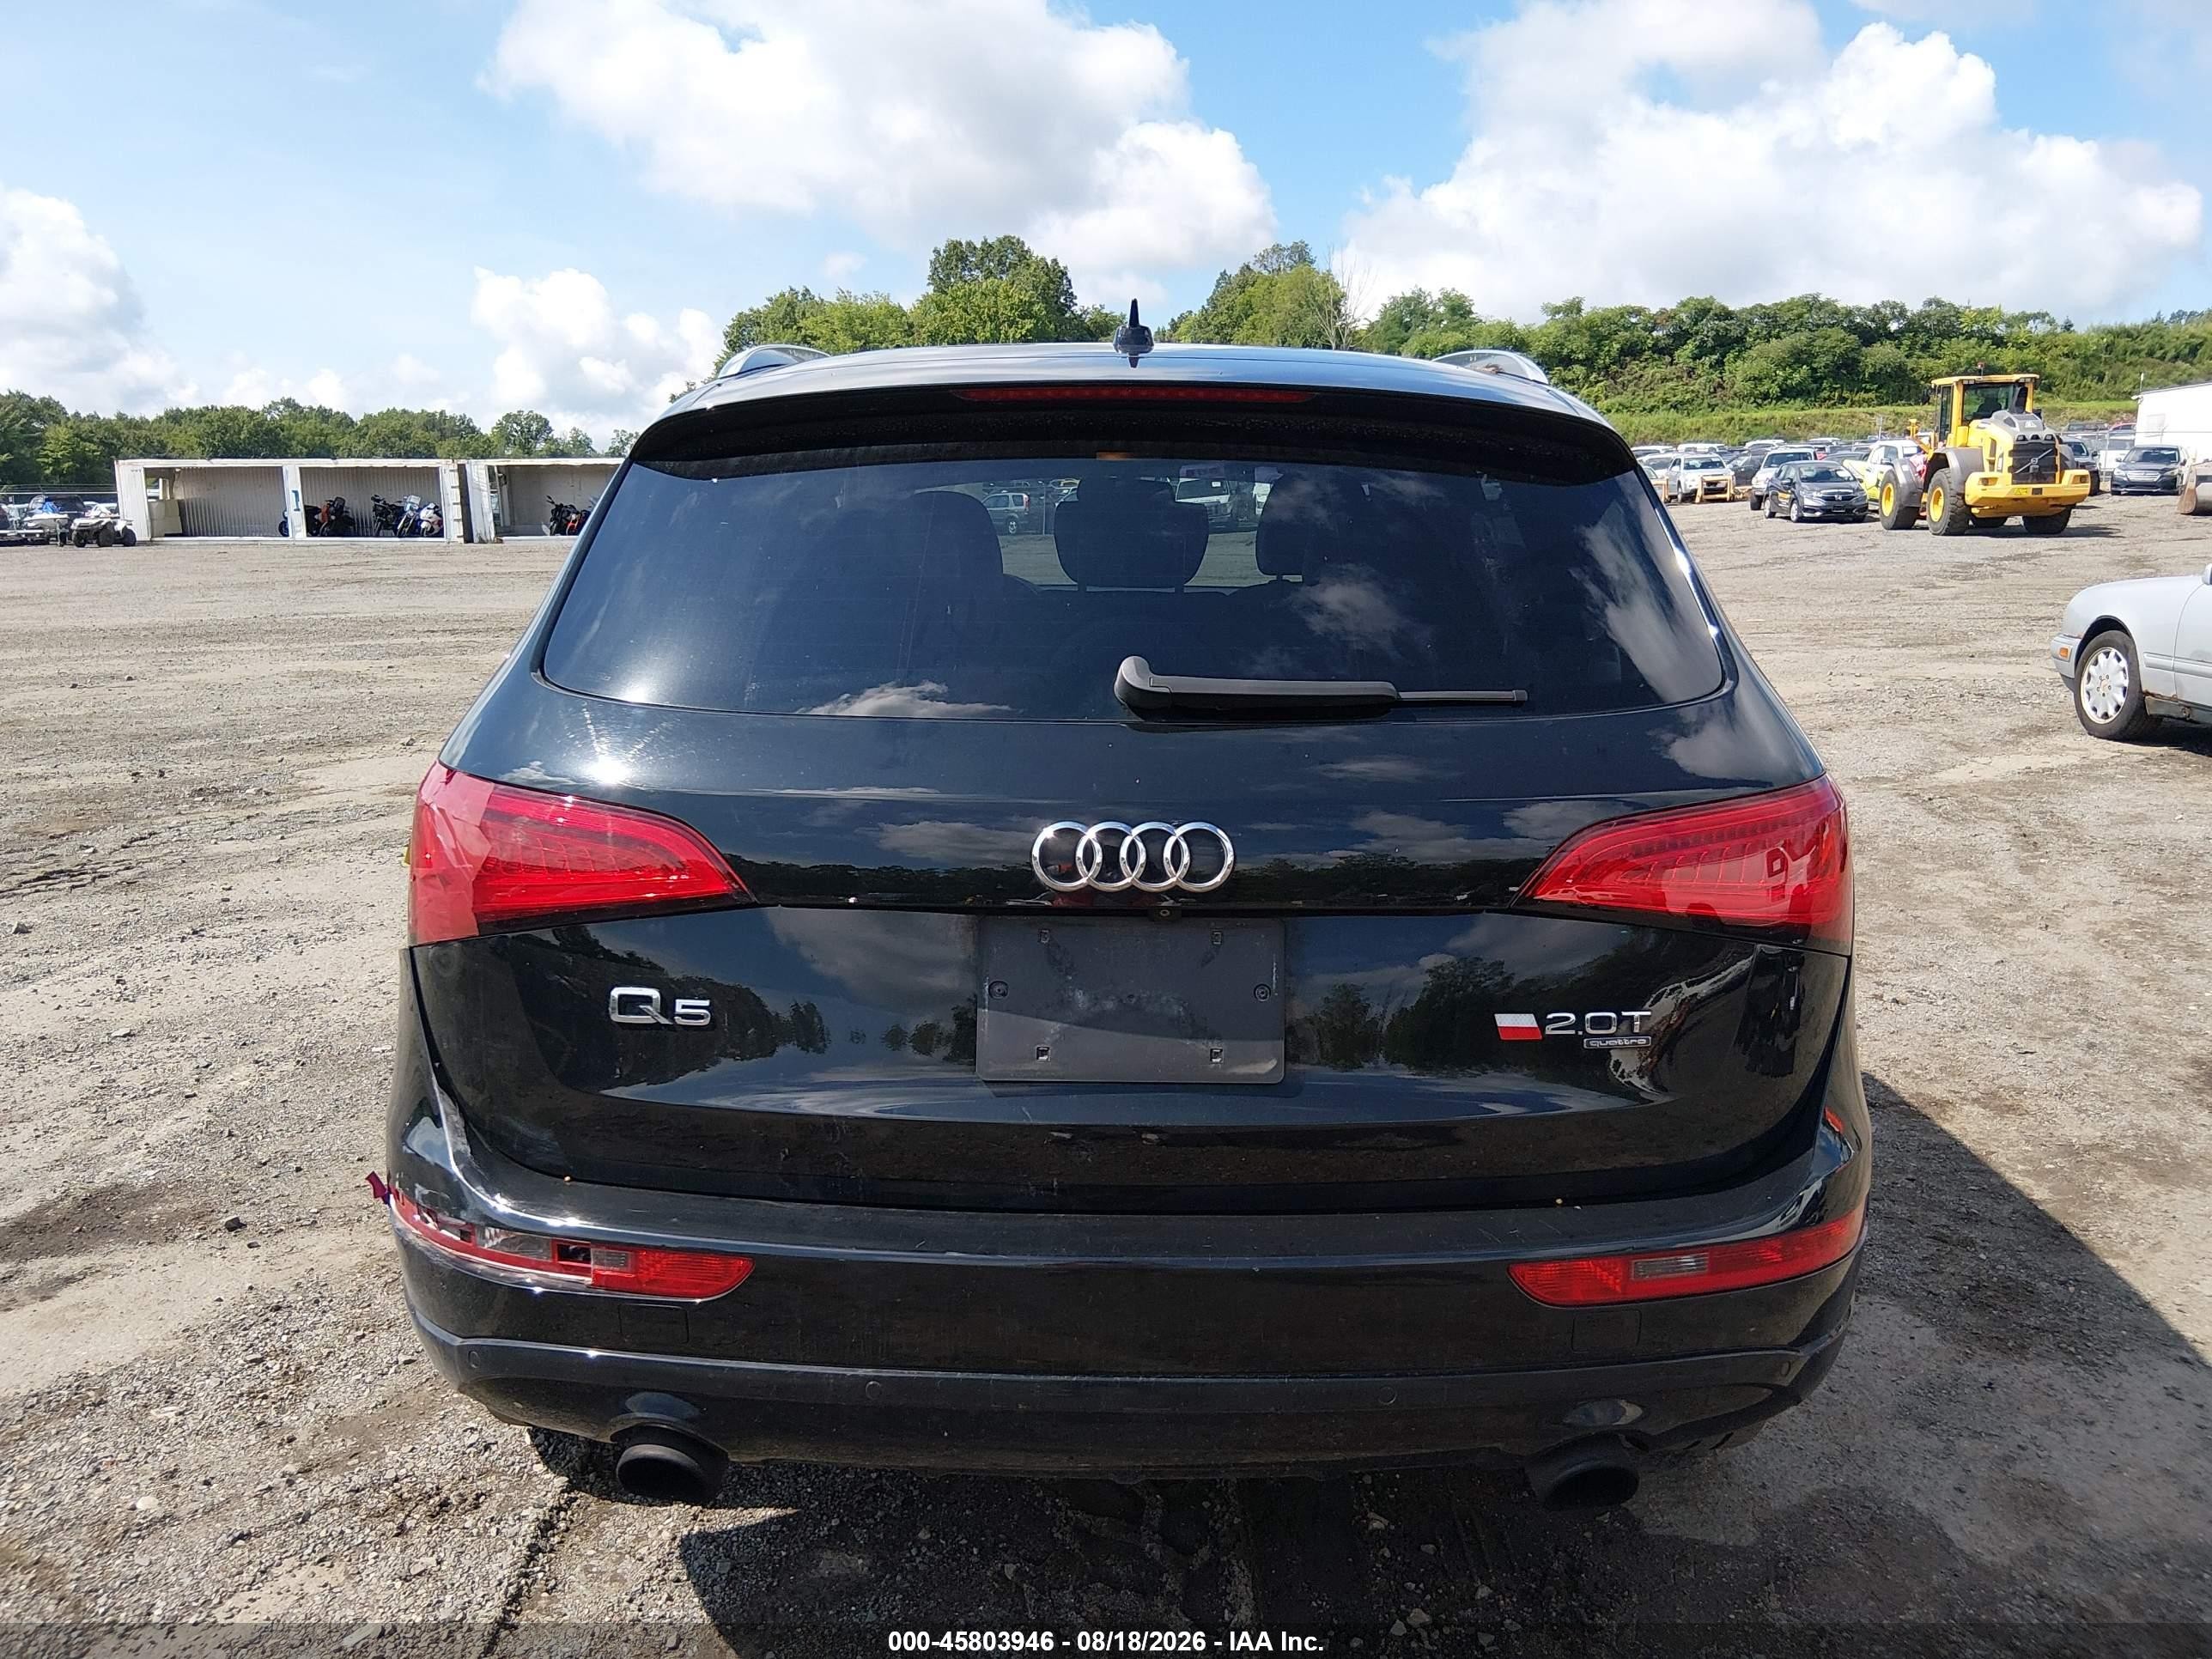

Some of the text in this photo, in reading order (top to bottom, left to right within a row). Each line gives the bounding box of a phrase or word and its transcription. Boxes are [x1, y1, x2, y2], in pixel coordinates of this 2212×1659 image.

[609, 987, 711, 1026] Q5
[1545, 1011, 1652, 1036] 2.0T
[1589, 1038, 1647, 1048] quattro
